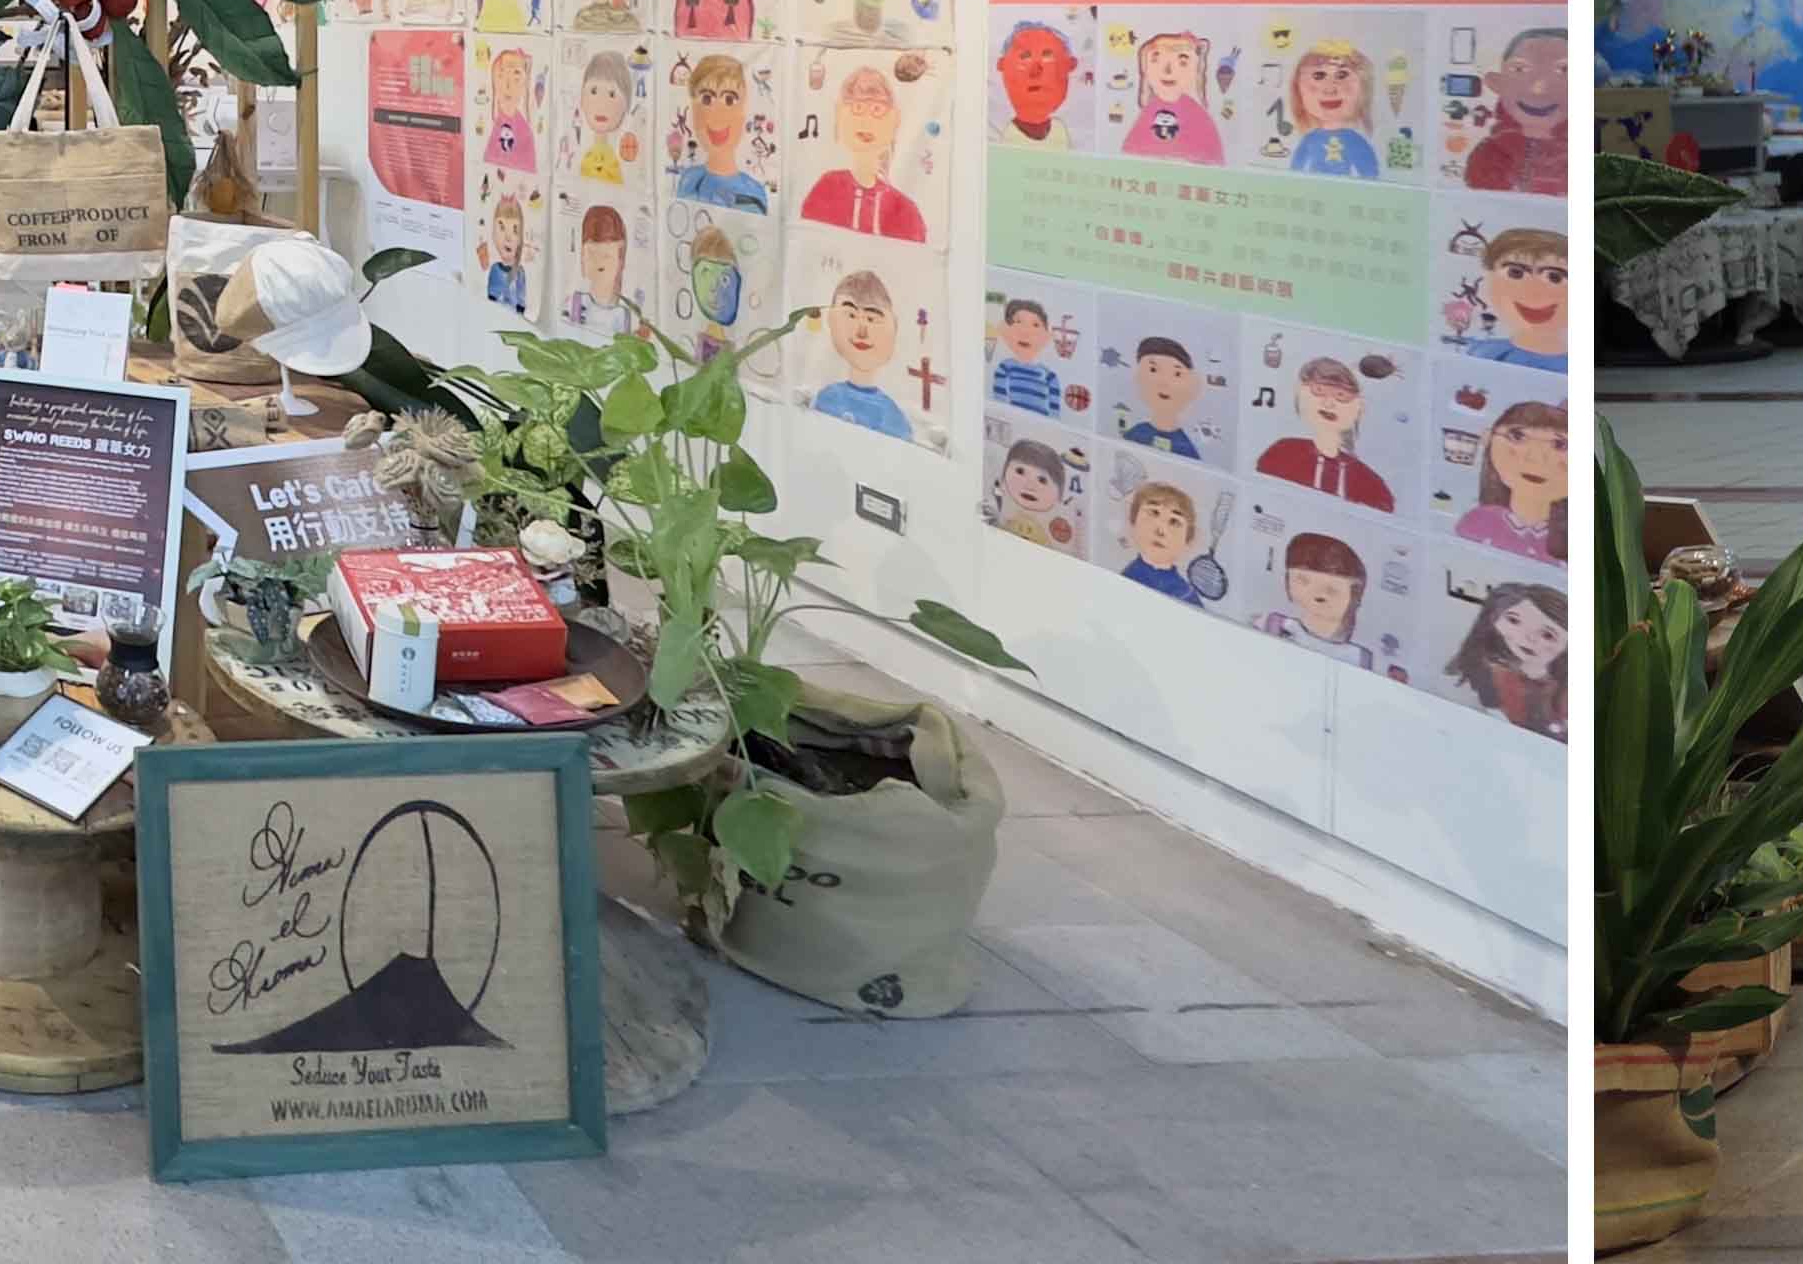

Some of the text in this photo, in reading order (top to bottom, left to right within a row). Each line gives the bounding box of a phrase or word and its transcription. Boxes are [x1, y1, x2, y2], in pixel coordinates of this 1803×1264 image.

[68, 205, 150, 223] PRODUCT
[18, 232, 67, 248] FROM
[95, 229, 119, 243] OF
[3, 428, 47, 444] SWING
[49, 435, 92, 450] REEDS
[249, 478, 323, 512] Let's
[52, 715, 125, 756] FOLLOW US
[290, 1050, 443, 1086] Seduce Your Taste
